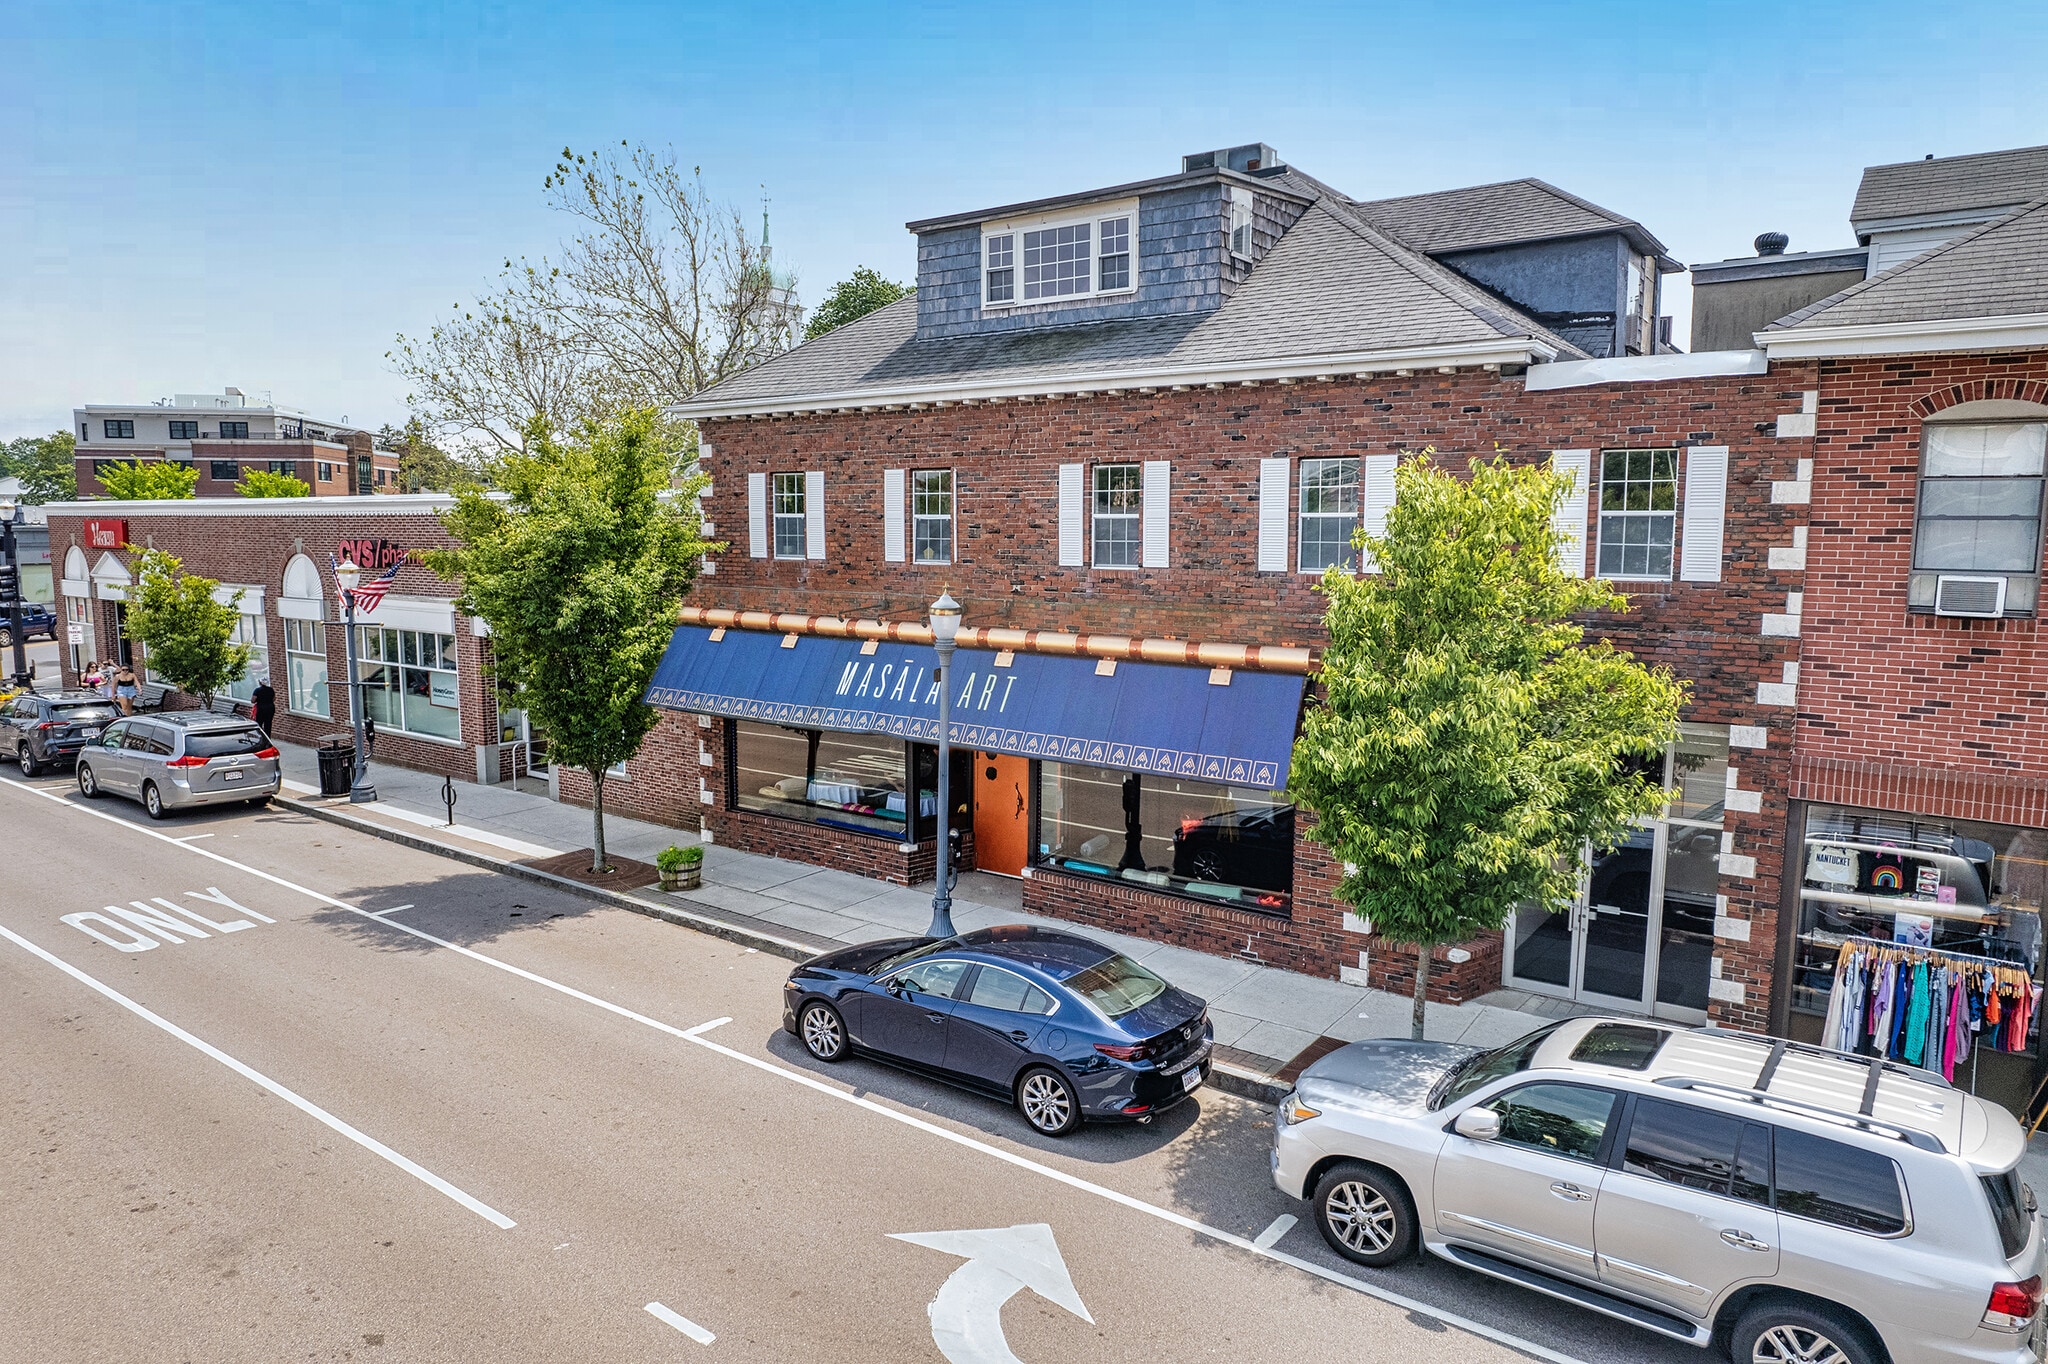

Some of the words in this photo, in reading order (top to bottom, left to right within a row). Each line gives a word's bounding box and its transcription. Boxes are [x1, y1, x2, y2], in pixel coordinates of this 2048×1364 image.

[957, 672, 1017, 713] ART
[1816, 853, 1850, 867] NANTUCKET
[60, 887, 277, 953] ONLY
